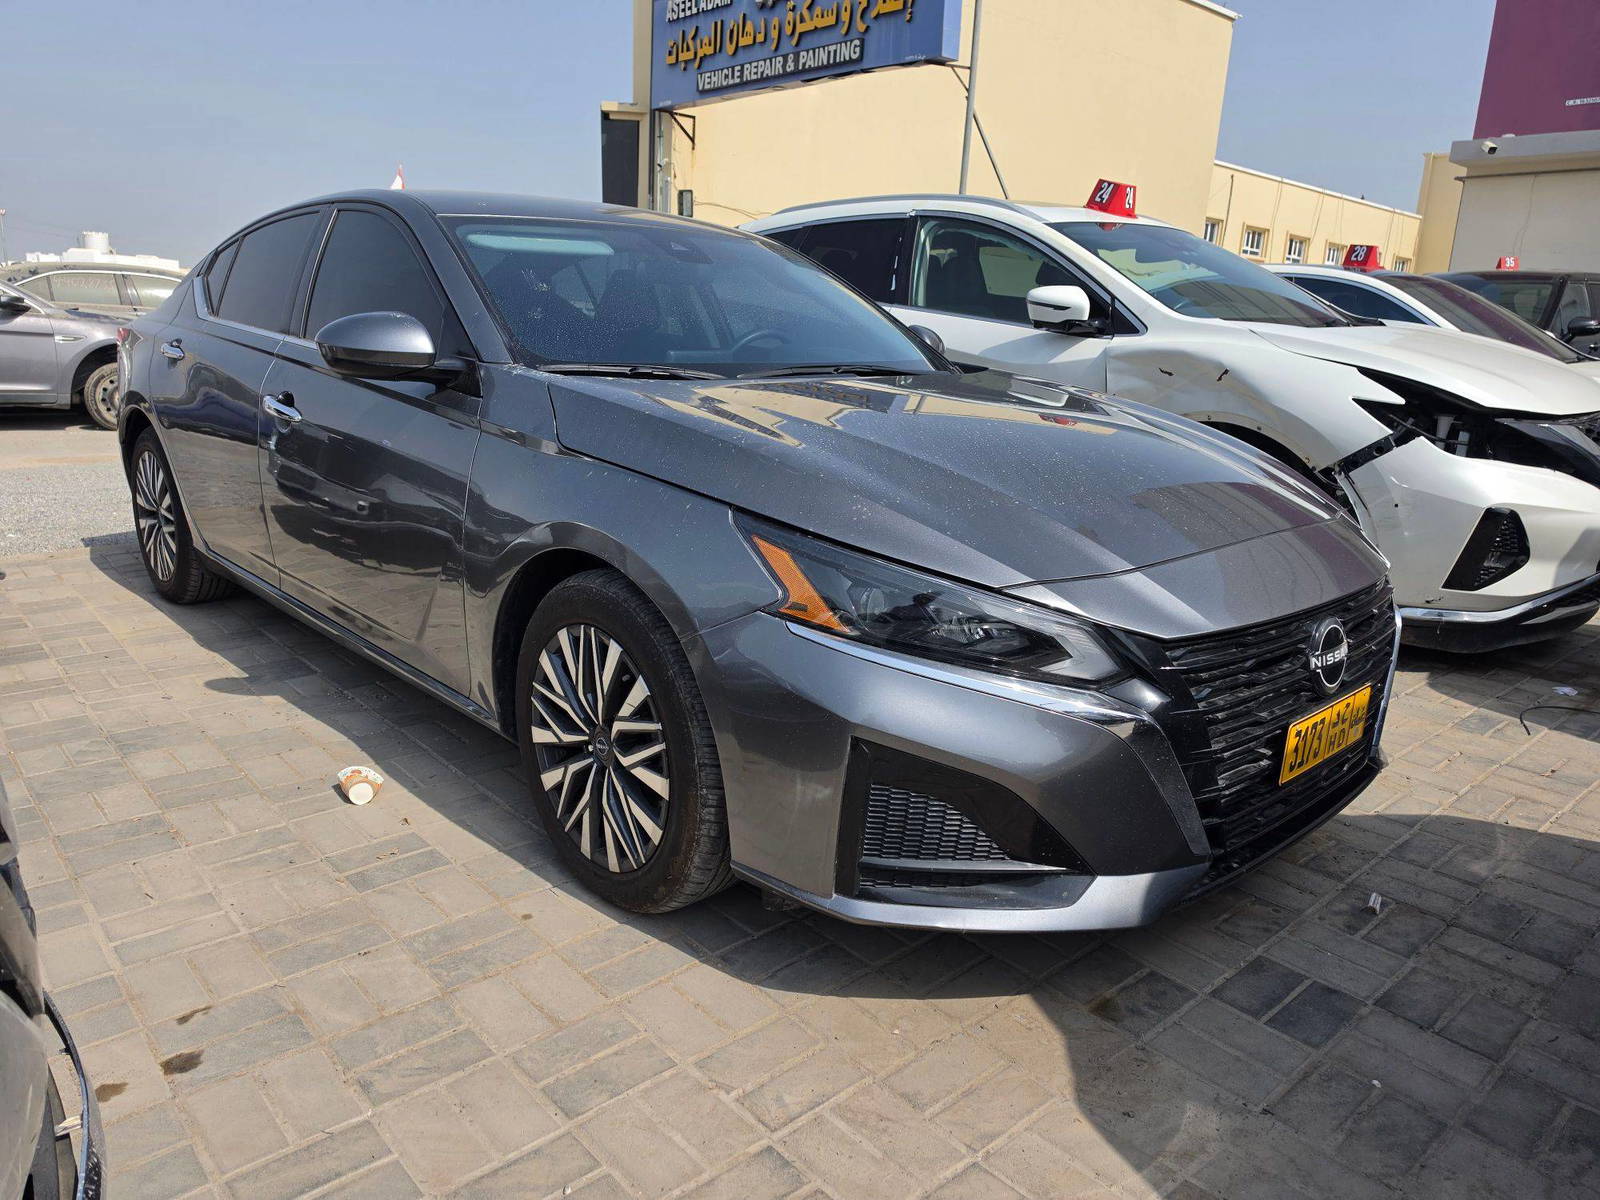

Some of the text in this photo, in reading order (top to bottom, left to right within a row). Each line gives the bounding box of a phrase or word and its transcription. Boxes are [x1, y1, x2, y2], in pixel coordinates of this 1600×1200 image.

[666, 0, 698, 22] ASEEL
[666, 19, 722, 71] المركبات
[726, 10, 766, 56] دهان
[698, 39, 861, 91] VEHICLE REPAIR & PAINTING
[1094, 181, 1115, 203] 24
[1351, 246, 1367, 261] 28
[1312, 644, 1348, 669] NISSA
